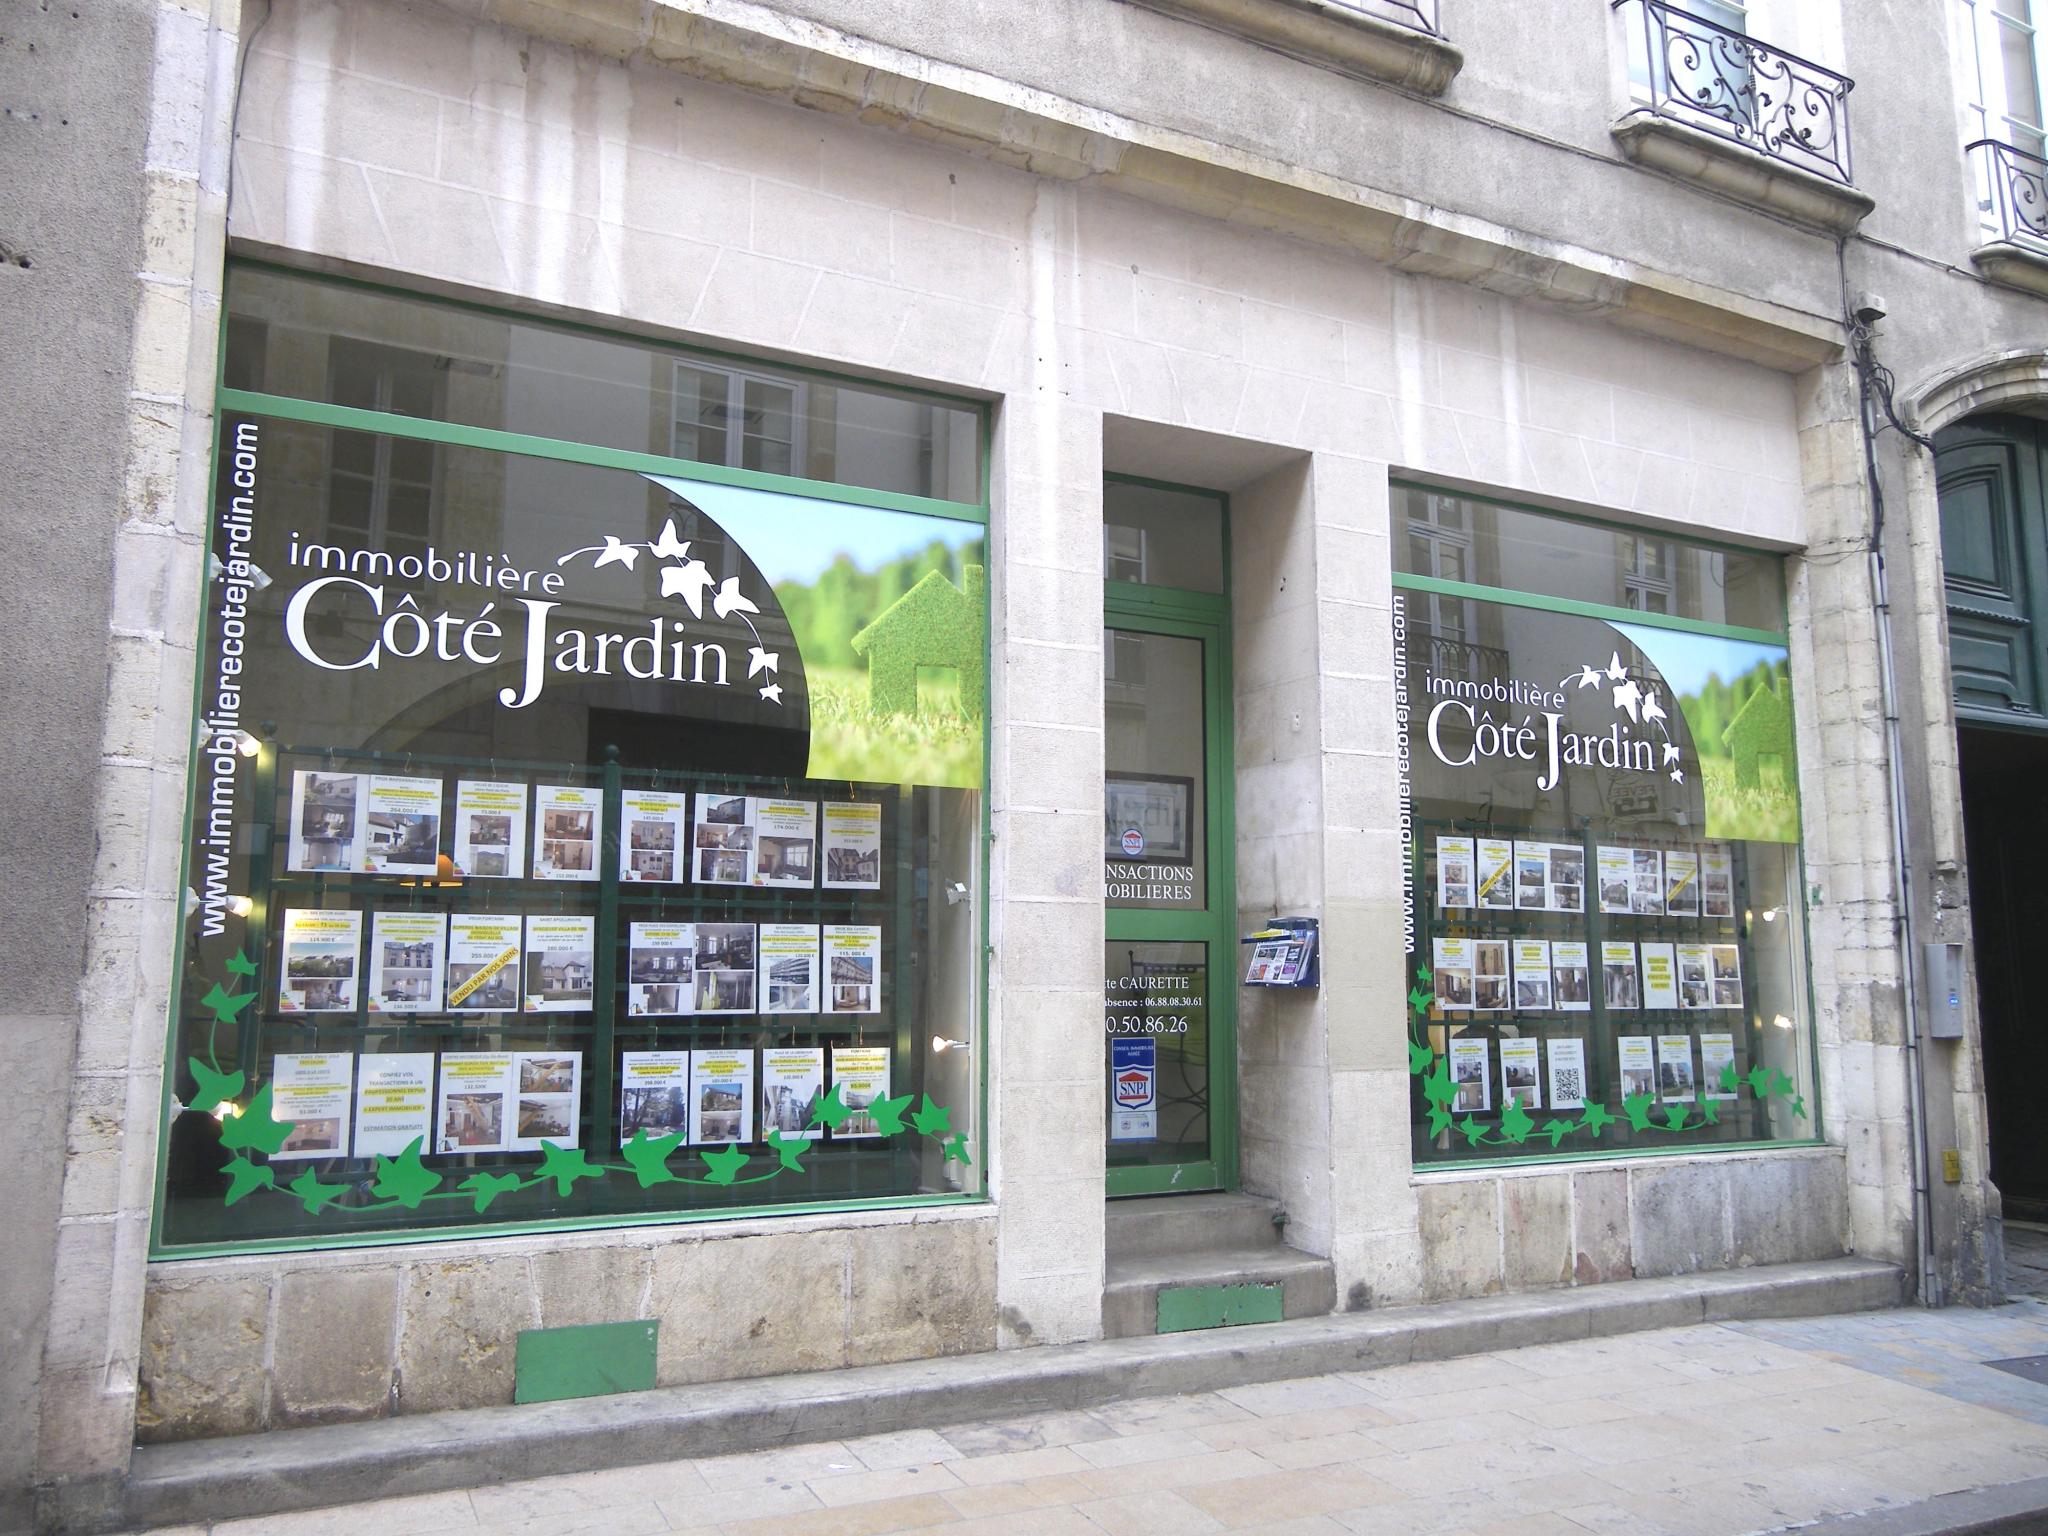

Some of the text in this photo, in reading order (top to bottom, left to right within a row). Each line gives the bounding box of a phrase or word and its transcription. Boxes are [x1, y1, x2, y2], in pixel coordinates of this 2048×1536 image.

[289, 531, 566, 595] immobilière
[284, 575, 731, 709] Côté Jardin
[202, 422, 259, 937] www.immobilierecotejardin.com
[1425, 669, 1566, 709] immobilière
[1426, 699, 1657, 792] Côté Jardin
[451, 947, 519, 1003] VENDU PAR NOS SOINS
[1104, 977, 1190, 989] te CAURETTE
[1145, 996, 1203, 1007] 06.88.08.30.61
[1120, 1081, 1147, 1096] SNPI
